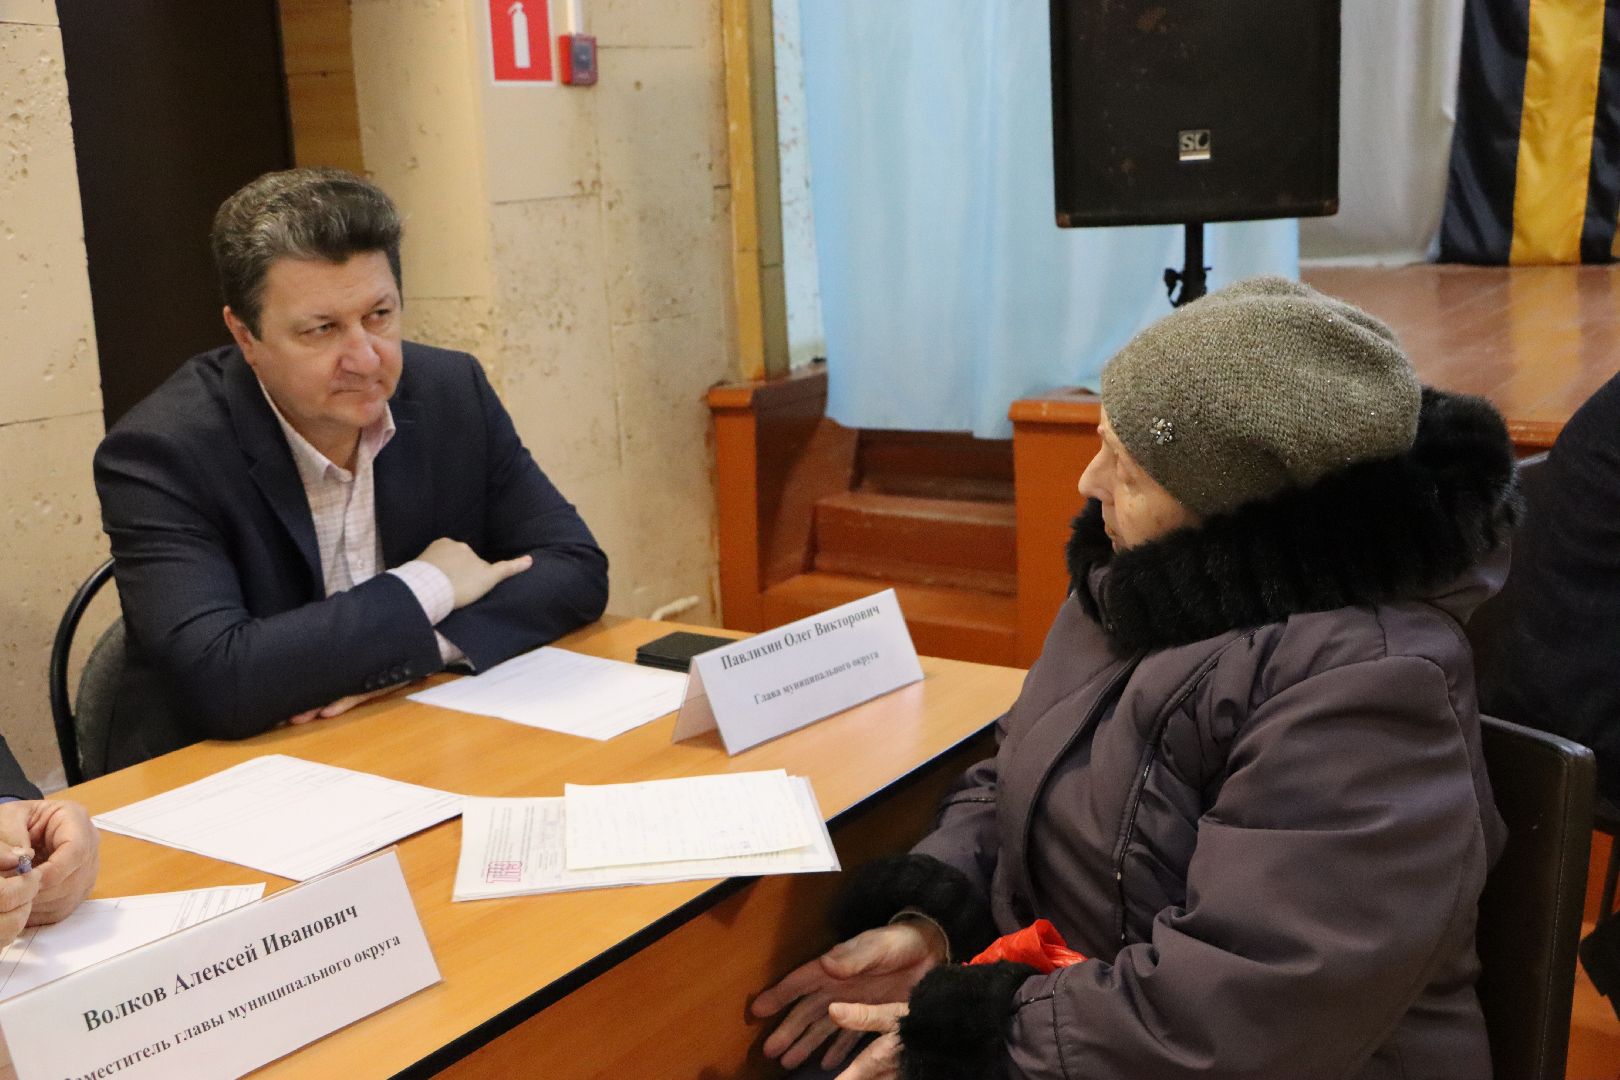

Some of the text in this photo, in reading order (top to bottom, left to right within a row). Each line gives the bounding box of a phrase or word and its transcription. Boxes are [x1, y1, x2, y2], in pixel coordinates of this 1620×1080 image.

[720, 605, 880, 670] Павлихин Олег Викторович
[753, 651, 880, 705] Глава муниципального округа
[64, 935, 401, 1080] меститель главы муниципального округа
[83, 987, 168, 1032] Волков
[174, 943, 258, 995] Алексей
[262, 905, 359, 956] Иванович
